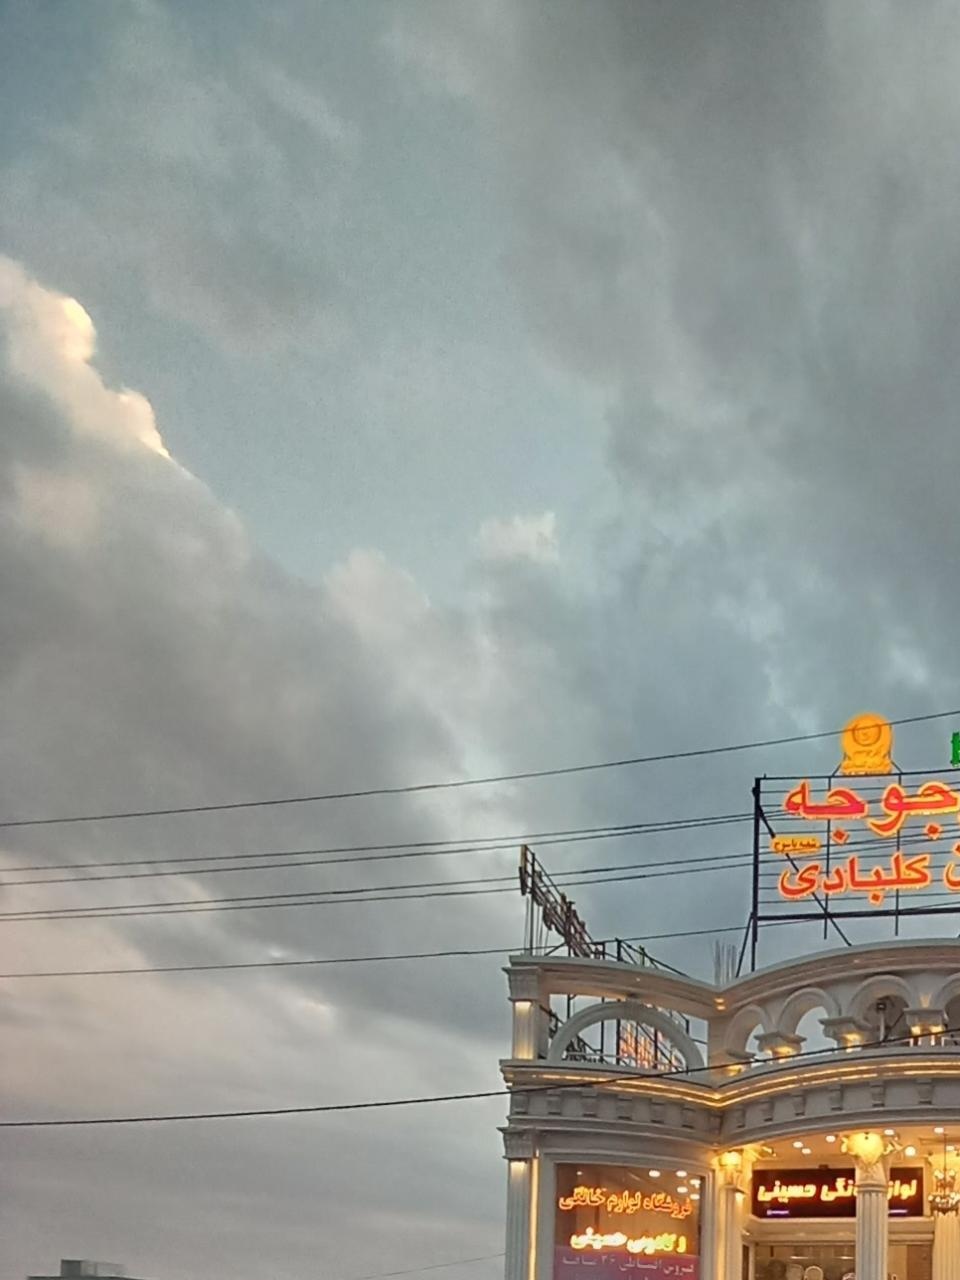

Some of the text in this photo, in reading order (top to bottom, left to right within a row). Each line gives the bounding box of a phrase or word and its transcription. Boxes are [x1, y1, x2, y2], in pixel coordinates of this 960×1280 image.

[778, 851, 931, 905] کلبادی
[559, 1186, 694, 1219] فروشگاه لوازم خانگی
[757, 1179, 816, 1203] حسینی
